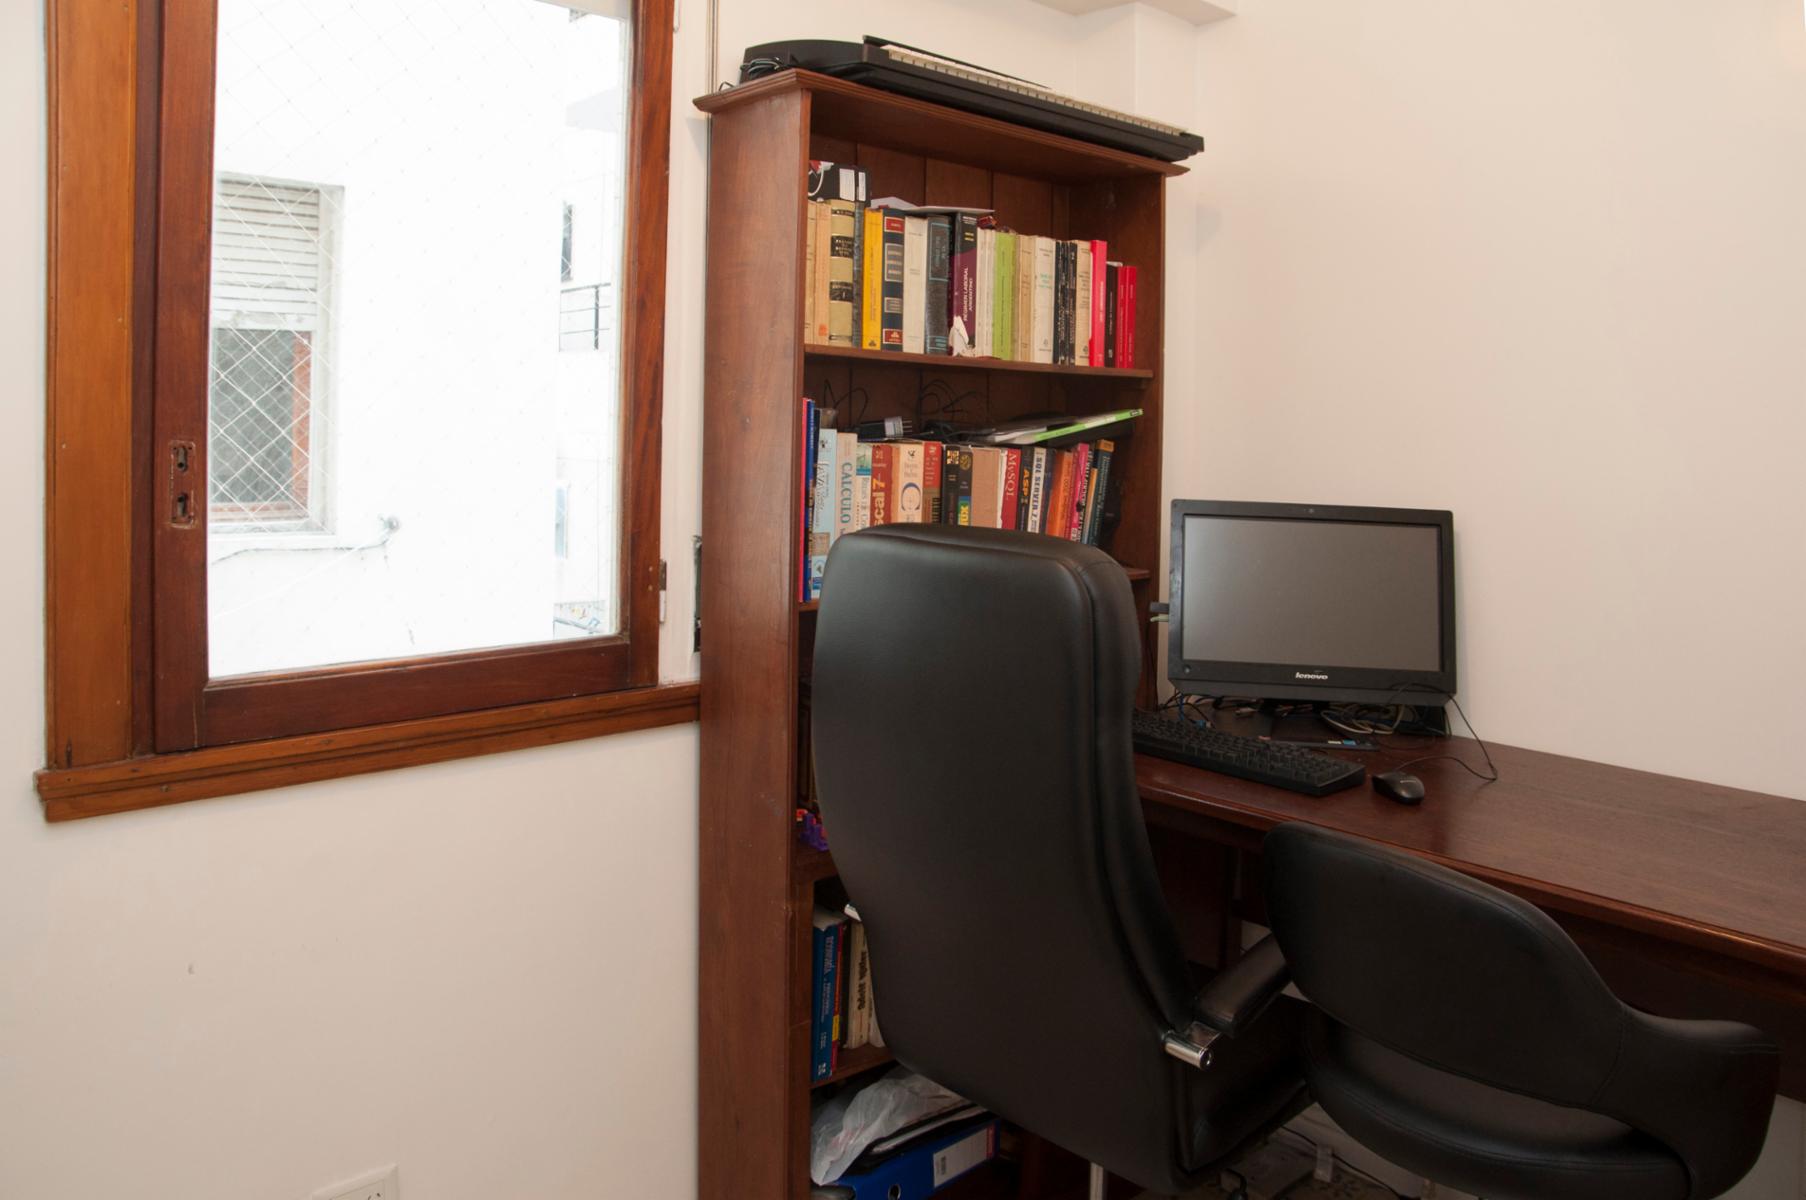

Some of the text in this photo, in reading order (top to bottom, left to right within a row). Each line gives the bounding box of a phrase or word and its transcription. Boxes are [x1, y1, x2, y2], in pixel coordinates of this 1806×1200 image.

[840, 462, 853, 524] CALCULO
[900, 481, 921, 512] C
[1022, 468, 1031, 497] ASP
[1032, 476, 1042, 511] SERVER
[872, 478, 886, 527] scal 7
[1295, 672, 1329, 680] lenovo
